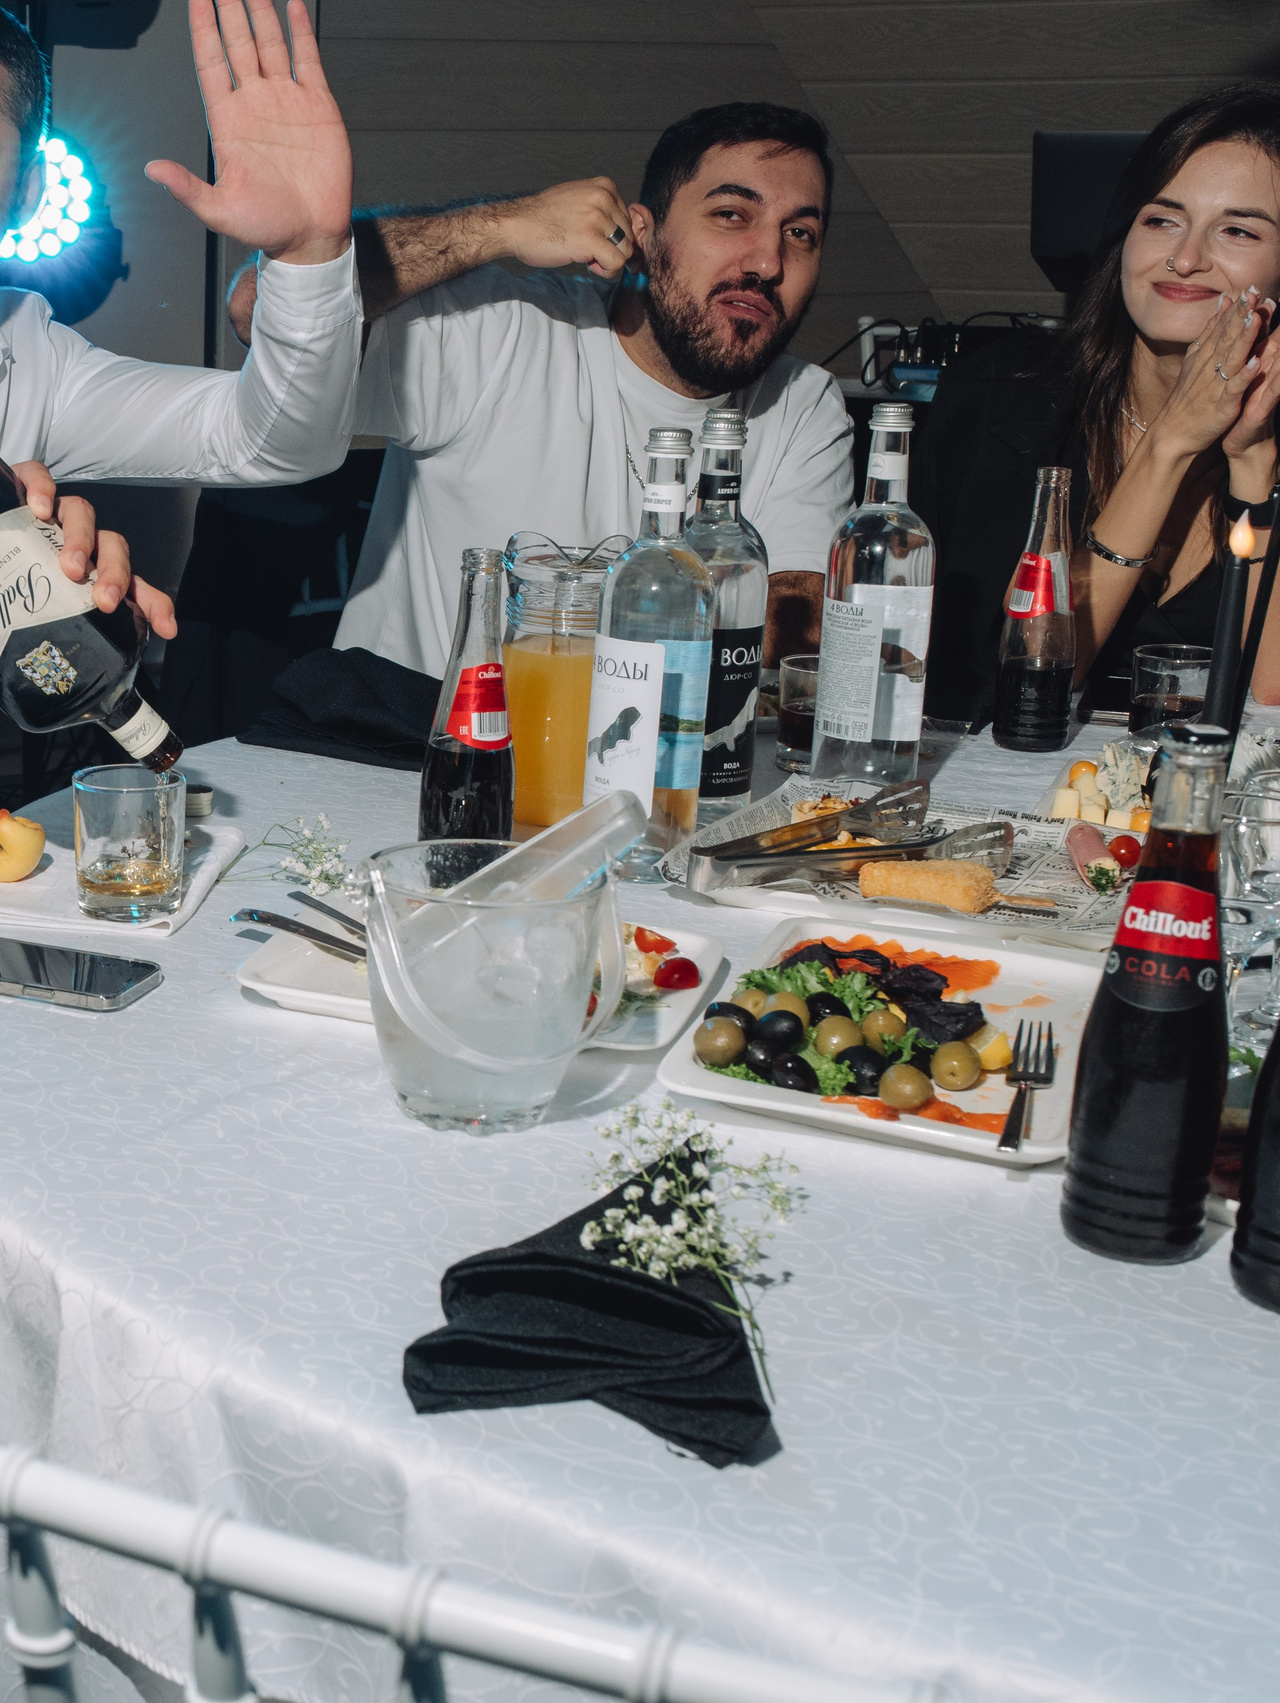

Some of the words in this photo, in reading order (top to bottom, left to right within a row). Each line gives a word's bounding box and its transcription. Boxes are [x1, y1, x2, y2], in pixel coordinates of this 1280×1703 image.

[830, 603, 835, 612] 4
[836, 604, 863, 617] ВОДЫ
[478, 671, 502, 679] Chillout
[597, 655, 648, 681] ВОДЫ
[723, 672, 753, 681] ДЮР-СО
[595, 775, 610, 785] ВОДА
[1124, 905, 1211, 941] Chillout
[1124, 957, 1192, 982] COLA
